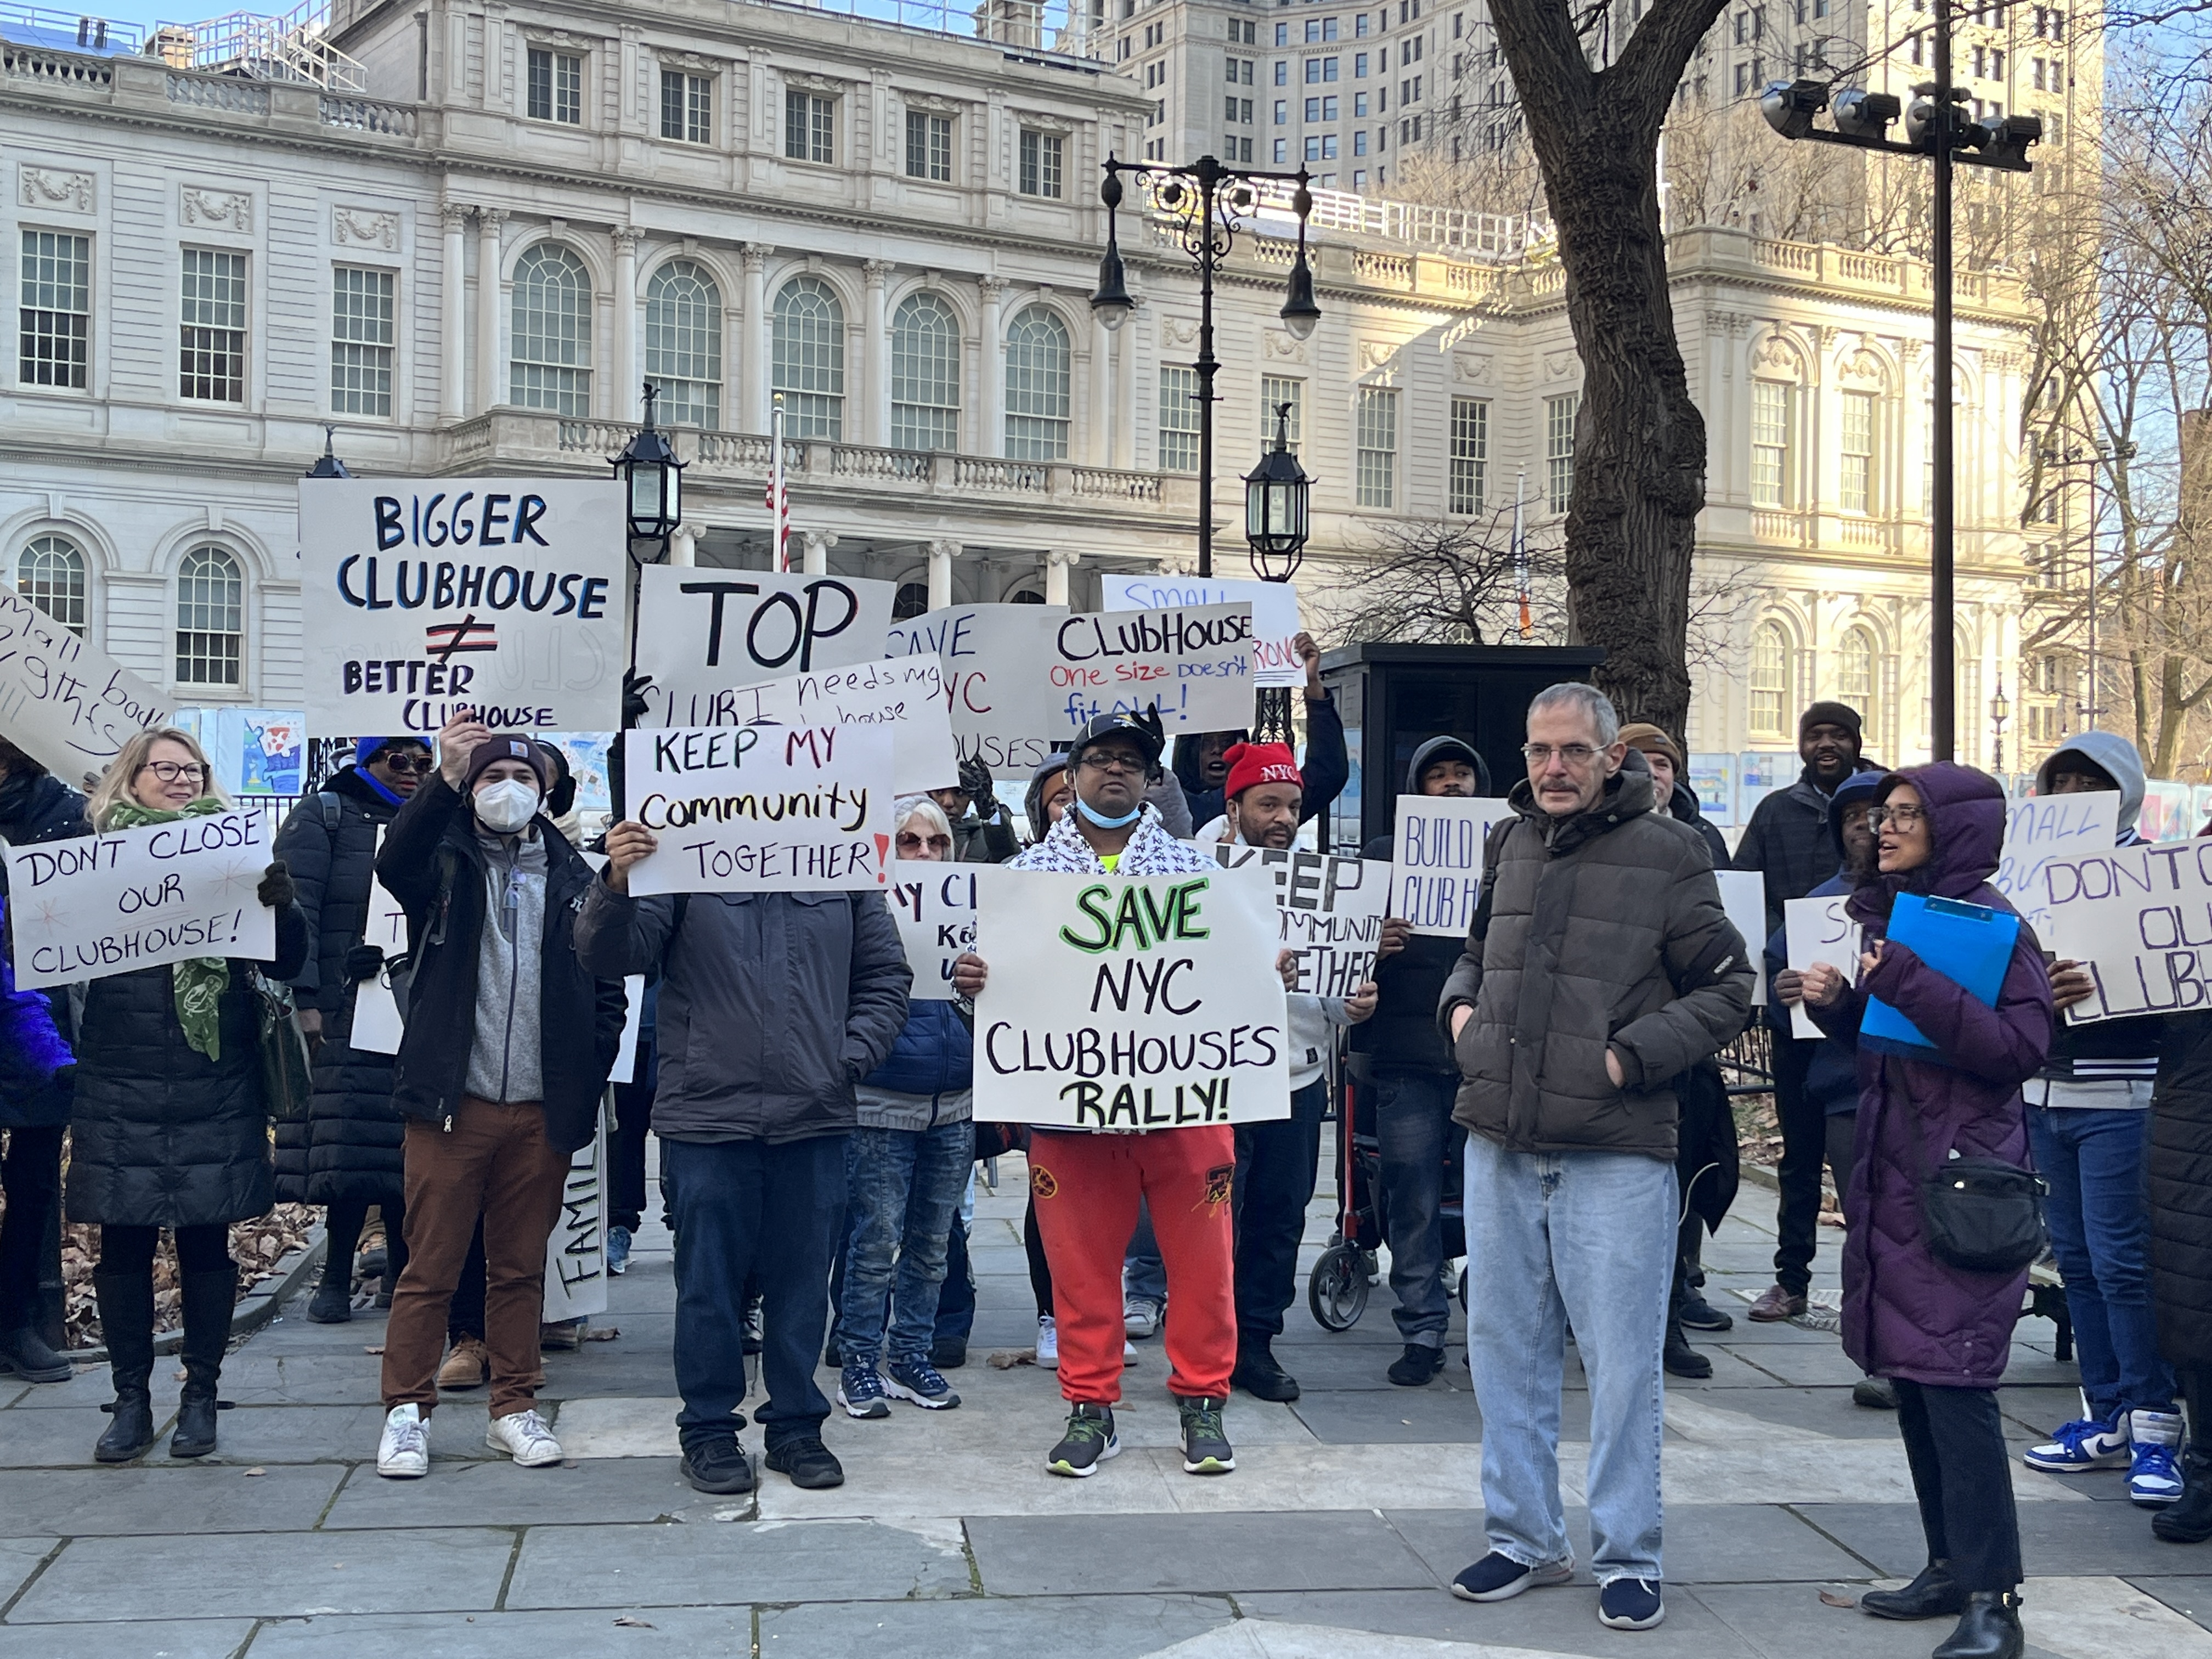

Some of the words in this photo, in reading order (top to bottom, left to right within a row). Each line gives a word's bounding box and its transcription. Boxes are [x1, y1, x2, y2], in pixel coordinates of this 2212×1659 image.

[373, 492, 550, 551] BIGGER
[337, 554, 608, 619] CLUBHOUSE
[0, 596, 81, 662] mall
[680, 580, 859, 673] TOP
[343, 659, 474, 696] BETTER
[1252, 636, 1305, 671] RONG
[796, 665, 895, 707] needs
[903, 665, 941, 702] my
[944, 672, 992, 714] YC
[1063, 692, 1102, 726] fit
[655, 728, 758, 774] KEEP
[785, 726, 837, 769] MY
[1260, 764, 1297, 782] NYC
[639, 782, 868, 832] Community
[2006, 803, 2100, 845] MALL
[149, 809, 262, 859] CLOSE
[682, 832, 890, 884] TOGETHER!
[1405, 816, 1472, 869] BUILD
[119, 873, 185, 915] OUR
[1058, 877, 1210, 955] SAVE
[1403, 876, 1455, 928] CLUB
[31, 909, 243, 974] CLUBHOUSE!
[2139, 902, 2212, 950] OU
[1090, 957, 1202, 1015] NYC
[1292, 946, 1378, 997] ETHER
[986, 1021, 1279, 1078] CLUBHOUSES
[1059, 1076, 1231, 1126] RALLY!
[556, 1140, 601, 1300] FAMIL
